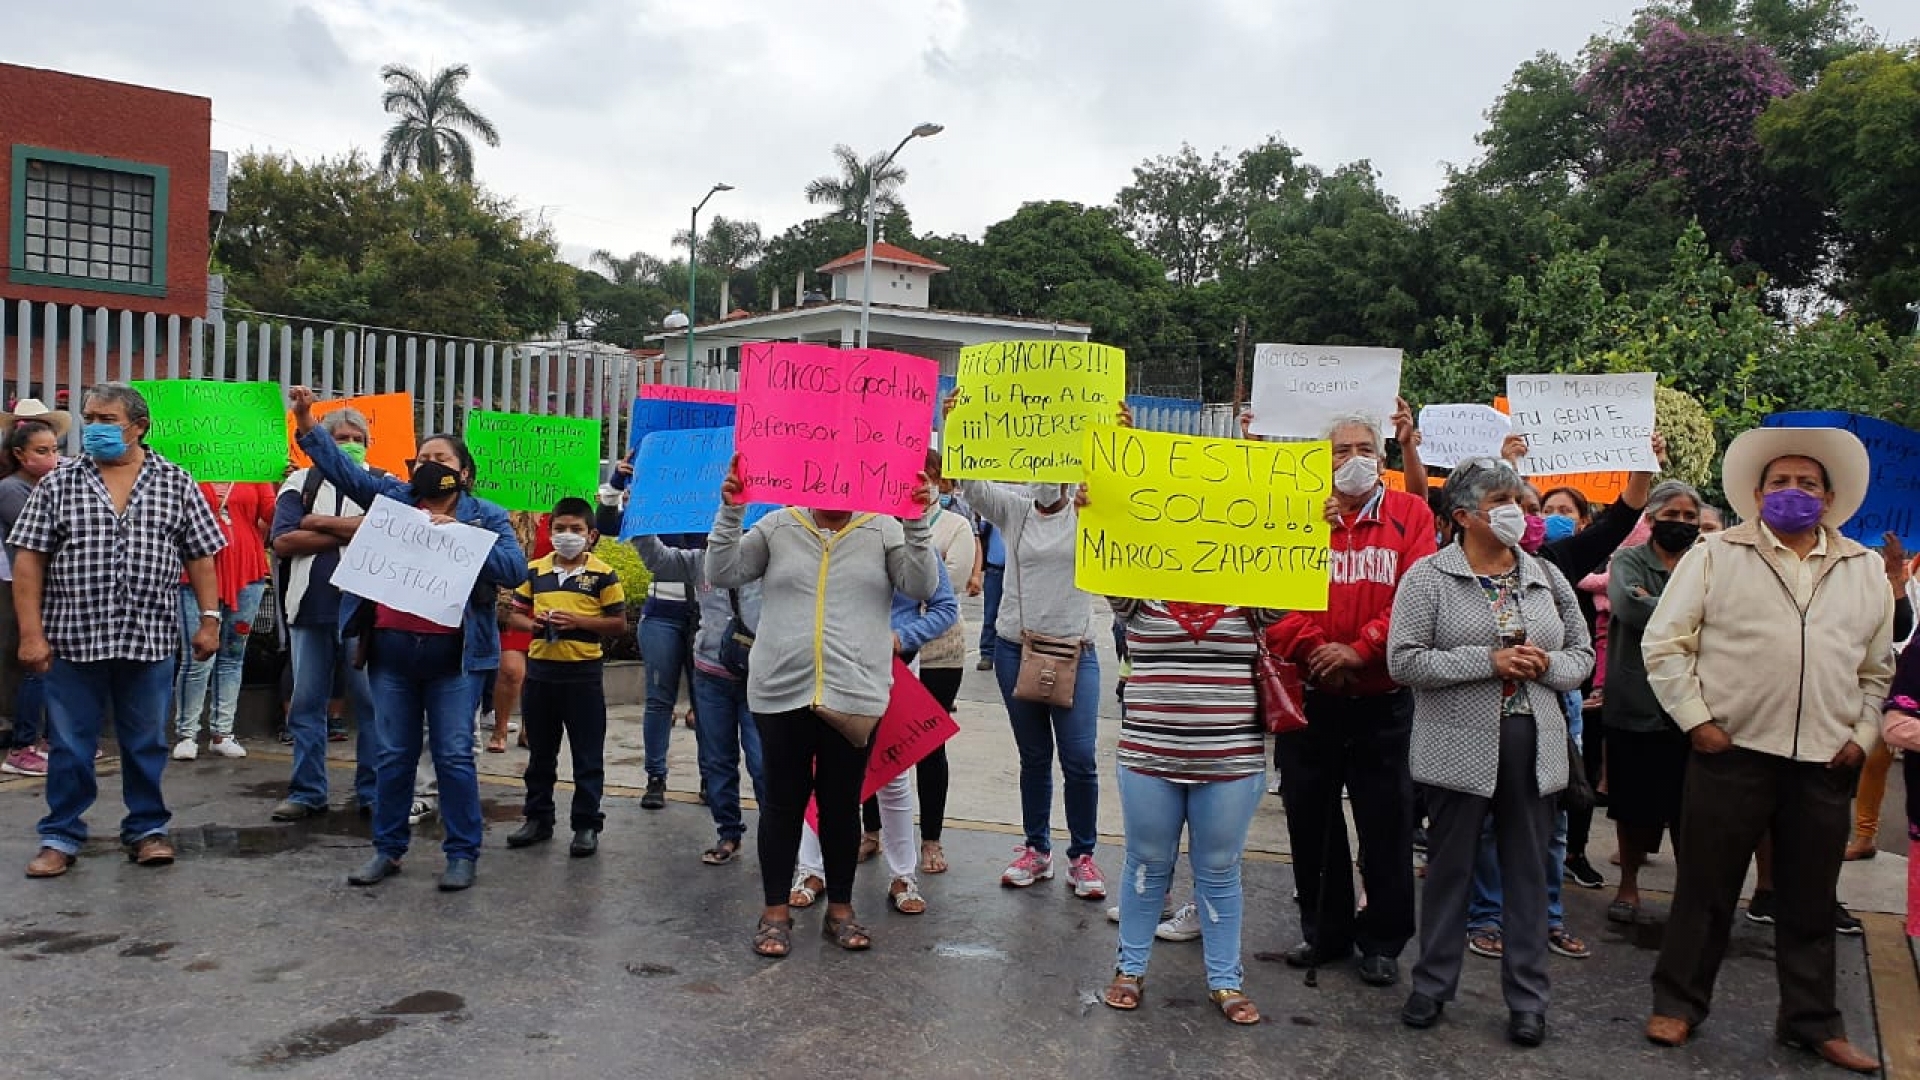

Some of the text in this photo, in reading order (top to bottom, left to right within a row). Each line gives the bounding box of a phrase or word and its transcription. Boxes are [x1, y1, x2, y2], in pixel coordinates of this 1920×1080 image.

[745, 345, 841, 394] Marcos
[1257, 350, 1341, 368] Marcos es
[184, 383, 275, 410] MARCOS
[1060, 387, 1075, 403] A
[1516, 380, 1642, 400] DIP MARCOS
[150, 415, 287, 438] ABEMOS DE
[467, 410, 518, 432] Marcos
[739, 402, 841, 443] Defensor
[854, 416, 886, 444] De
[1513, 404, 1624, 427] TU GENTE
[1518, 425, 1651, 447] TE APOYA ERES
[177, 458, 274, 477] RABAJO
[947, 443, 1002, 472] Marcos
[1091, 430, 1325, 493] NO ESTAS
[802, 460, 827, 494] De
[860, 459, 912, 506] Muje
[1128, 488, 1314, 534] SOLO!!!
[369, 507, 475, 568] QUEREMOS
[1082, 527, 1183, 572] MARCOS
[351, 546, 449, 598] JUSTICIA
[870, 714, 944, 774] apotitlan
